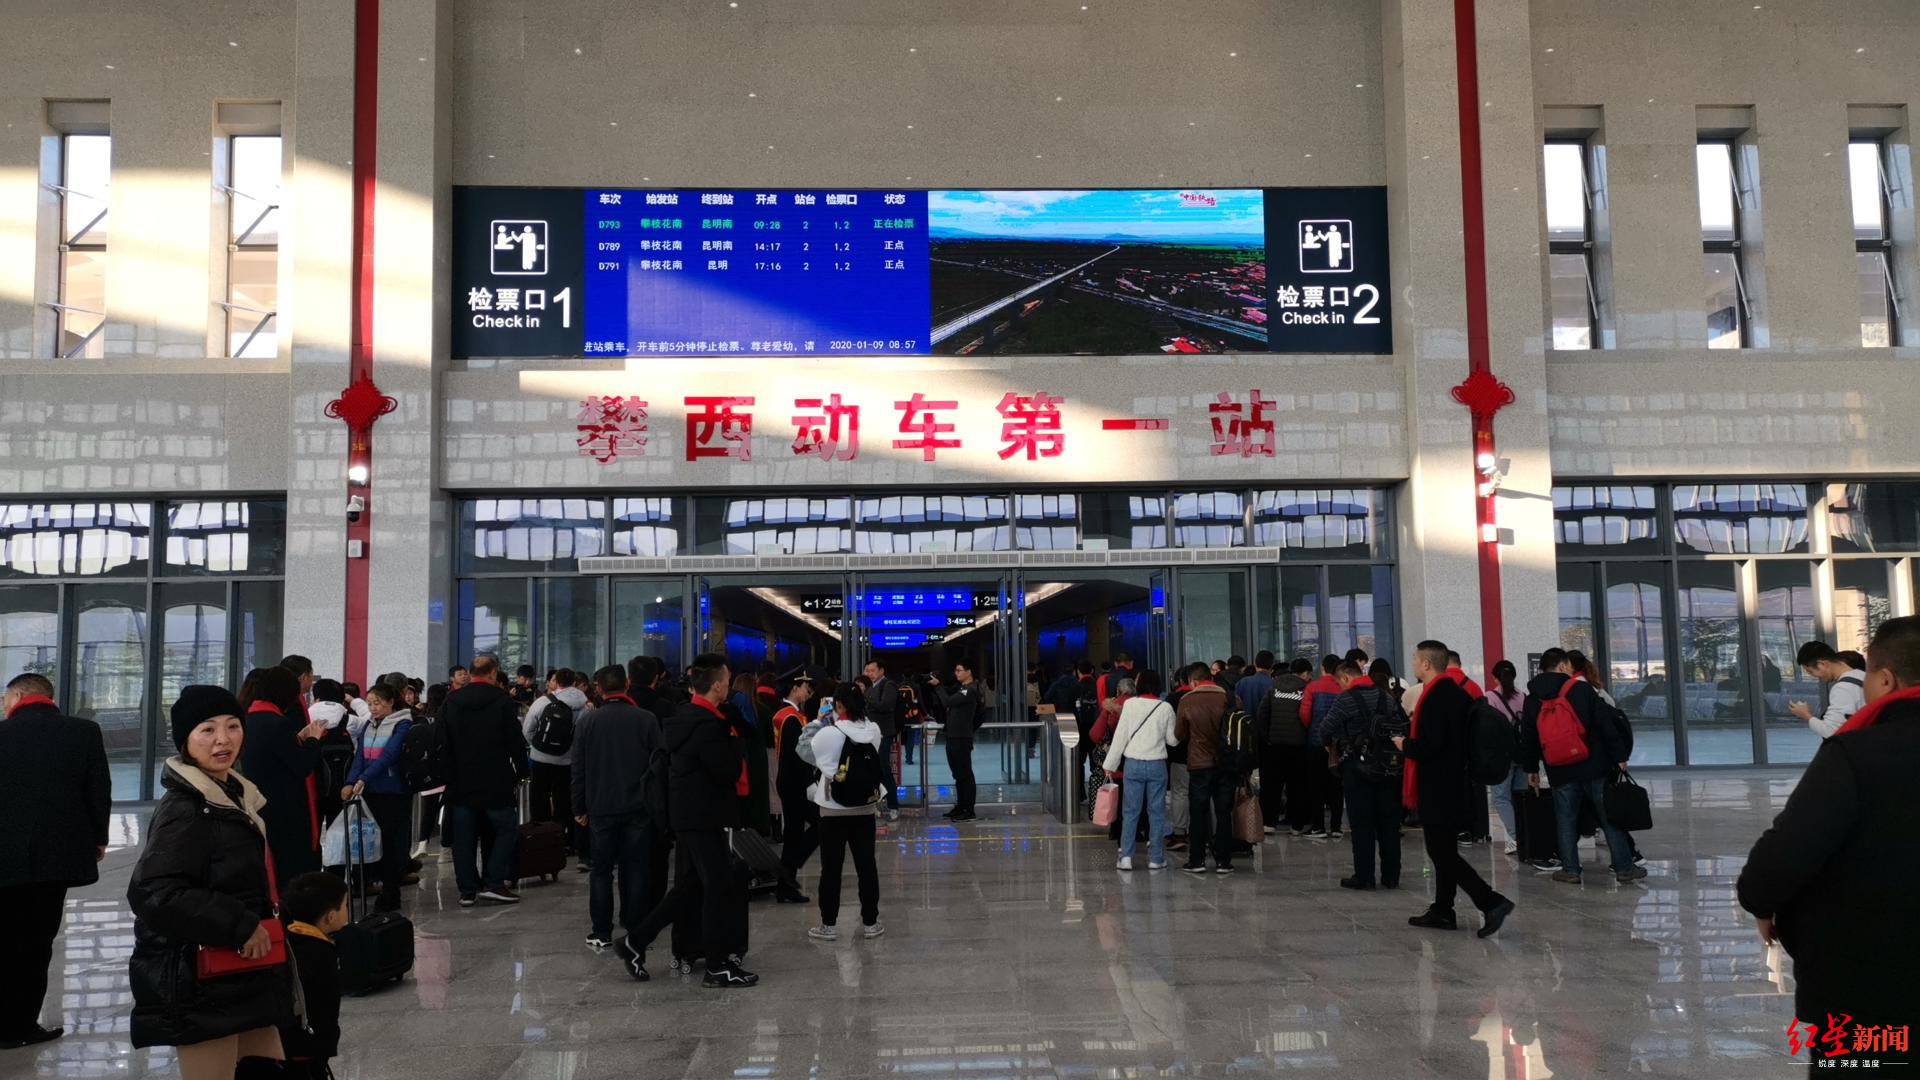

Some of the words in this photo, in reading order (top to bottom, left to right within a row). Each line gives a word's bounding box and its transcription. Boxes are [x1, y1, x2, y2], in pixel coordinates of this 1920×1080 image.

[599, 193, 622, 205] 车次
[645, 193, 679, 205] 始发站
[701, 193, 734, 205] 终到站
[755, 193, 778, 205] 开点
[794, 193, 816, 205] 站台
[826, 193, 858, 205] 检票口
[884, 193, 906, 205] 状态
[598, 220, 621, 229] D793
[640, 218, 683, 229] 攀枝花南
[702, 218, 733, 229] 昆明南
[753, 221, 781, 230] 09:28
[802, 221, 809, 230] 2
[873, 218, 915, 229] 正在检票
[598, 242, 621, 251] D789
[640, 240, 683, 251] 攀枝花南
[702, 240, 733, 251] 昆明南
[754, 242, 781, 251] 14:17
[803, 242, 809, 251] 2
[884, 240, 905, 251] 正点
[598, 262, 620, 271] D791
[640, 260, 683, 271] 攀枝花南
[707, 260, 728, 271] 昆明
[754, 262, 782, 271] 17:16
[803, 262, 810, 271] 2
[884, 259, 905, 270] 正点
[468, 286, 546, 311] 检票口
[1277, 284, 1350, 309] 检票口
[552, 286, 571, 328] 1
[1353, 283, 1381, 325] 2
[472, 314, 523, 328] Check
[525, 314, 541, 328] in
[1281, 311, 1330, 325] Check
[1331, 311, 1345, 325] in
[830, 340, 884, 350] 2020-01-09
[888, 340, 916, 350] 08:57
[576, 389, 1277, 465] 攀西动车第一站
